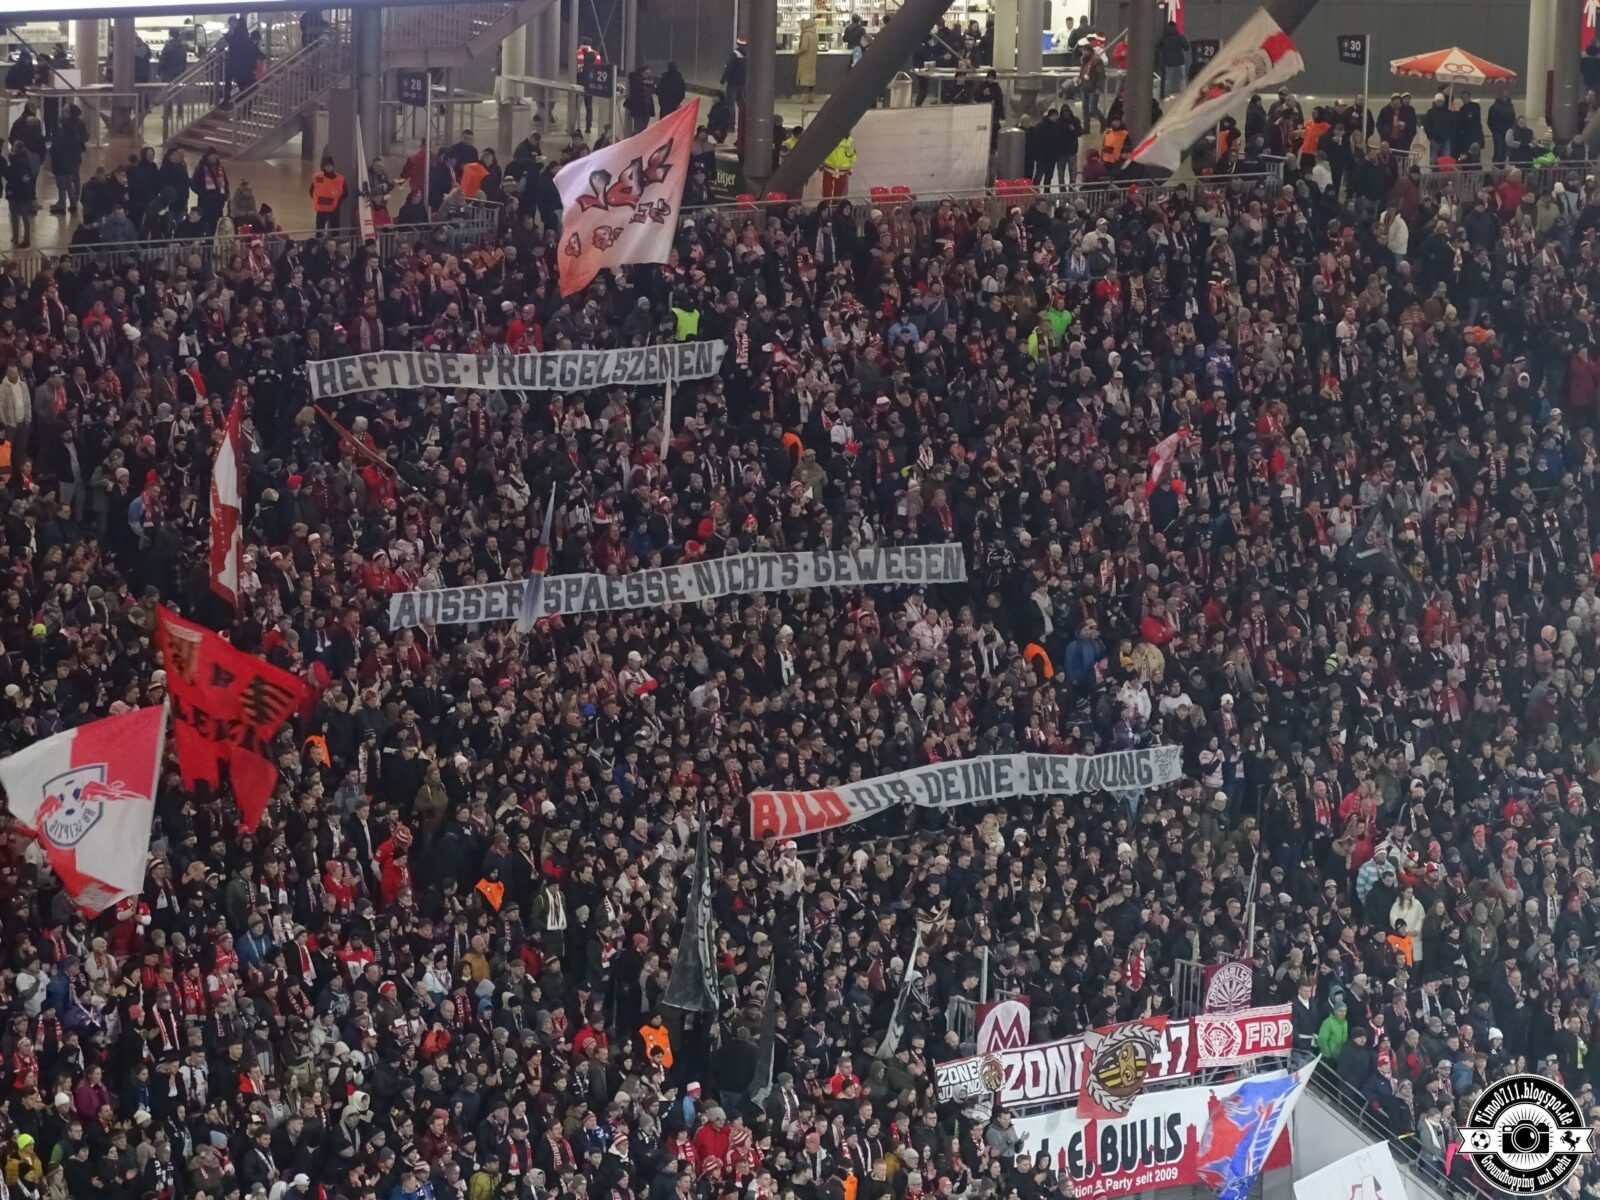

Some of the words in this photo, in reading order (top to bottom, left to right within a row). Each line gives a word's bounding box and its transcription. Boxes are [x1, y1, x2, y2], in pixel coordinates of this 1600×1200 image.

[1204, 45, 1215, 56] 29
[1350, 40, 1361, 51] 30
[411, 79, 422, 91] 28
[596, 70, 607, 82] 29
[316, 351, 461, 395] HEFTIGE
[542, 571, 687, 614] SPAESSE
[698, 557, 800, 600] NICHTS
[814, 545, 963, 584] GEWESEN
[752, 790, 852, 840] BILD
[860, 782, 914, 812] DIR
[917, 757, 1014, 806] DEINE
[1027, 749, 1154, 792] MEINUNG
[1245, 1019, 1293, 1050] FRP
[1146, 1024, 1190, 1078] 47
[937, 1061, 979, 1087] ZONE
[938, 1079, 980, 1100] JUEND
[1101, 1112, 1183, 1175] BULLS
[1073, 1186, 1093, 1199] tion
[1106, 1176, 1133, 1192] Party
[1136, 1172, 1153, 1186] seit
[1155, 1168, 1179, 1183] 2009
